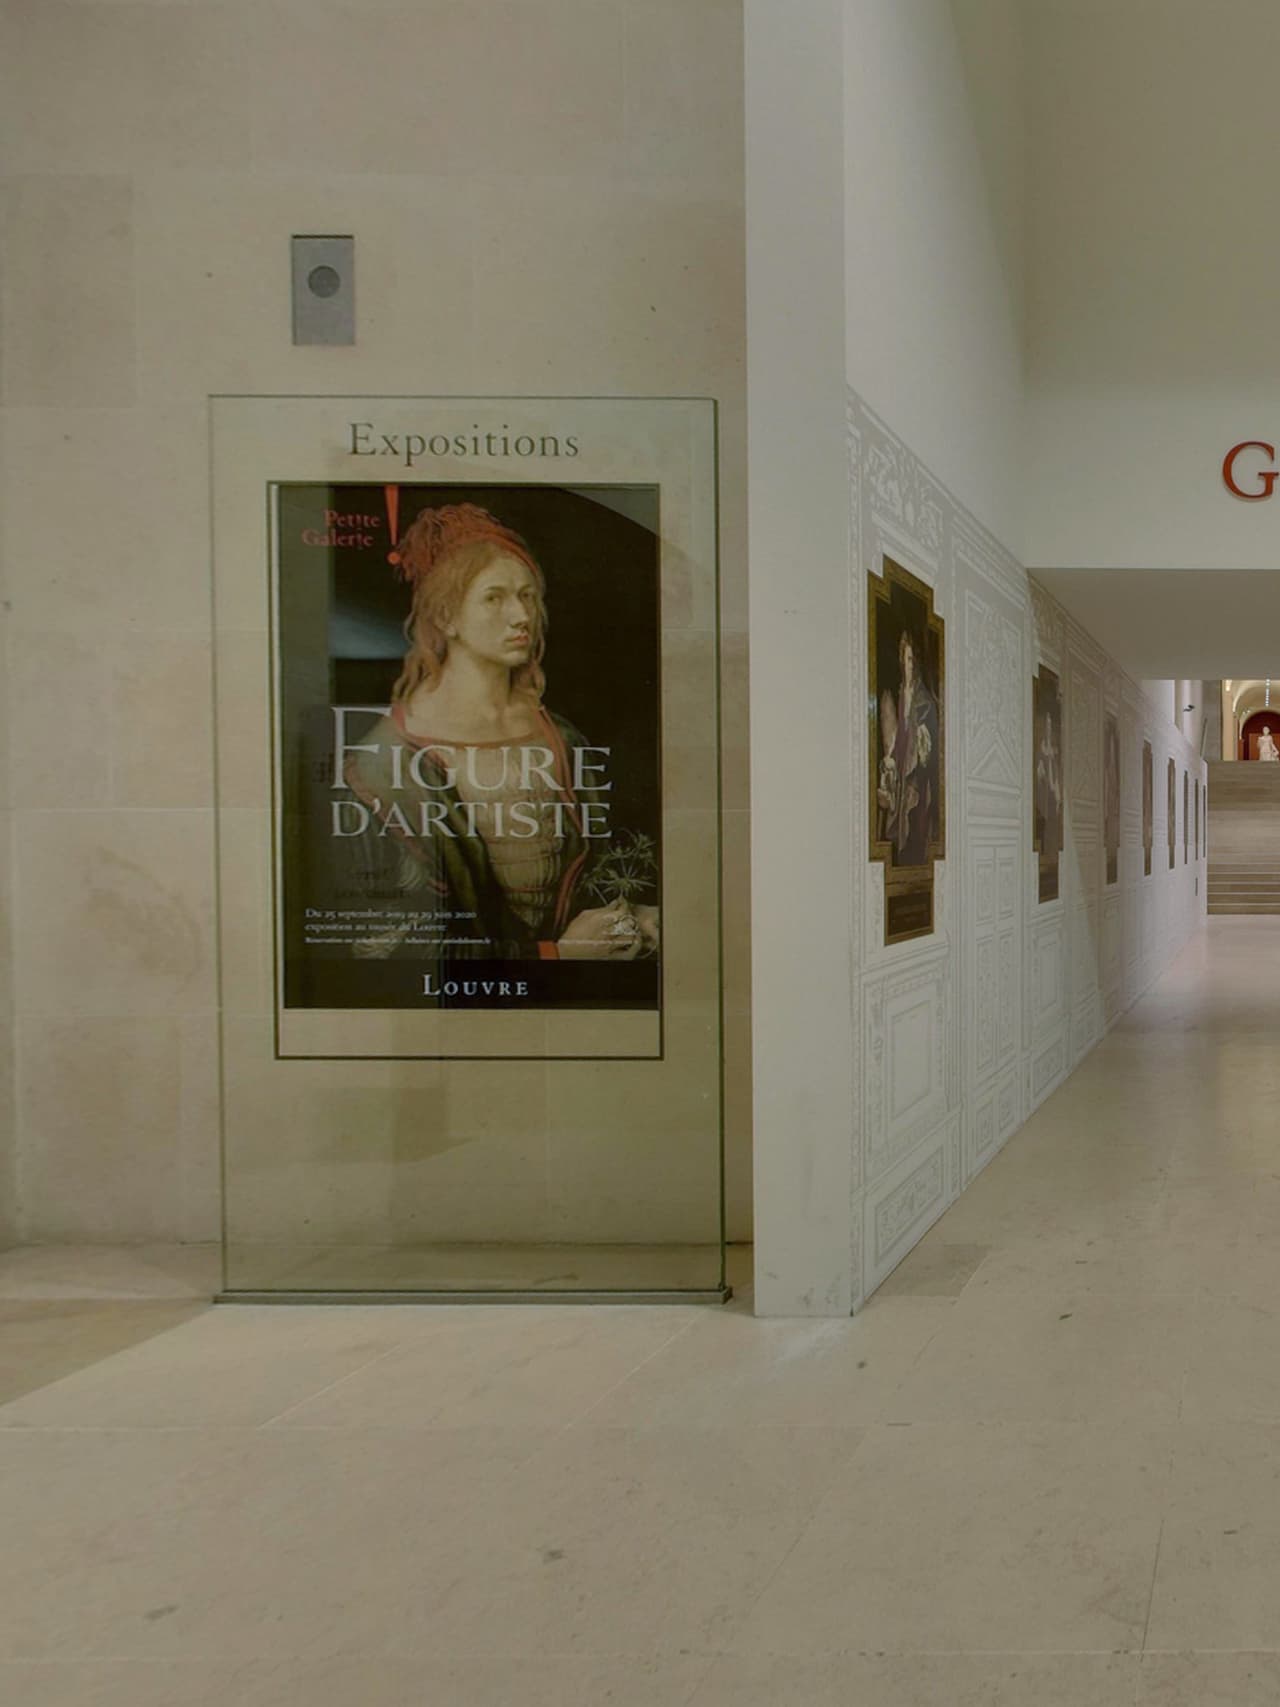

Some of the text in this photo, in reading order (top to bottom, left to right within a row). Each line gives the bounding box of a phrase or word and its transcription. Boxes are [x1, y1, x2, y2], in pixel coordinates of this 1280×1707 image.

[348, 422, 579, 466] Expositions
[330, 706, 612, 791] FIGURE
[330, 798, 612, 839] D'ARTISTE
[304, 908, 321, 918] Du
[423, 974, 529, 996] LOUVRE
